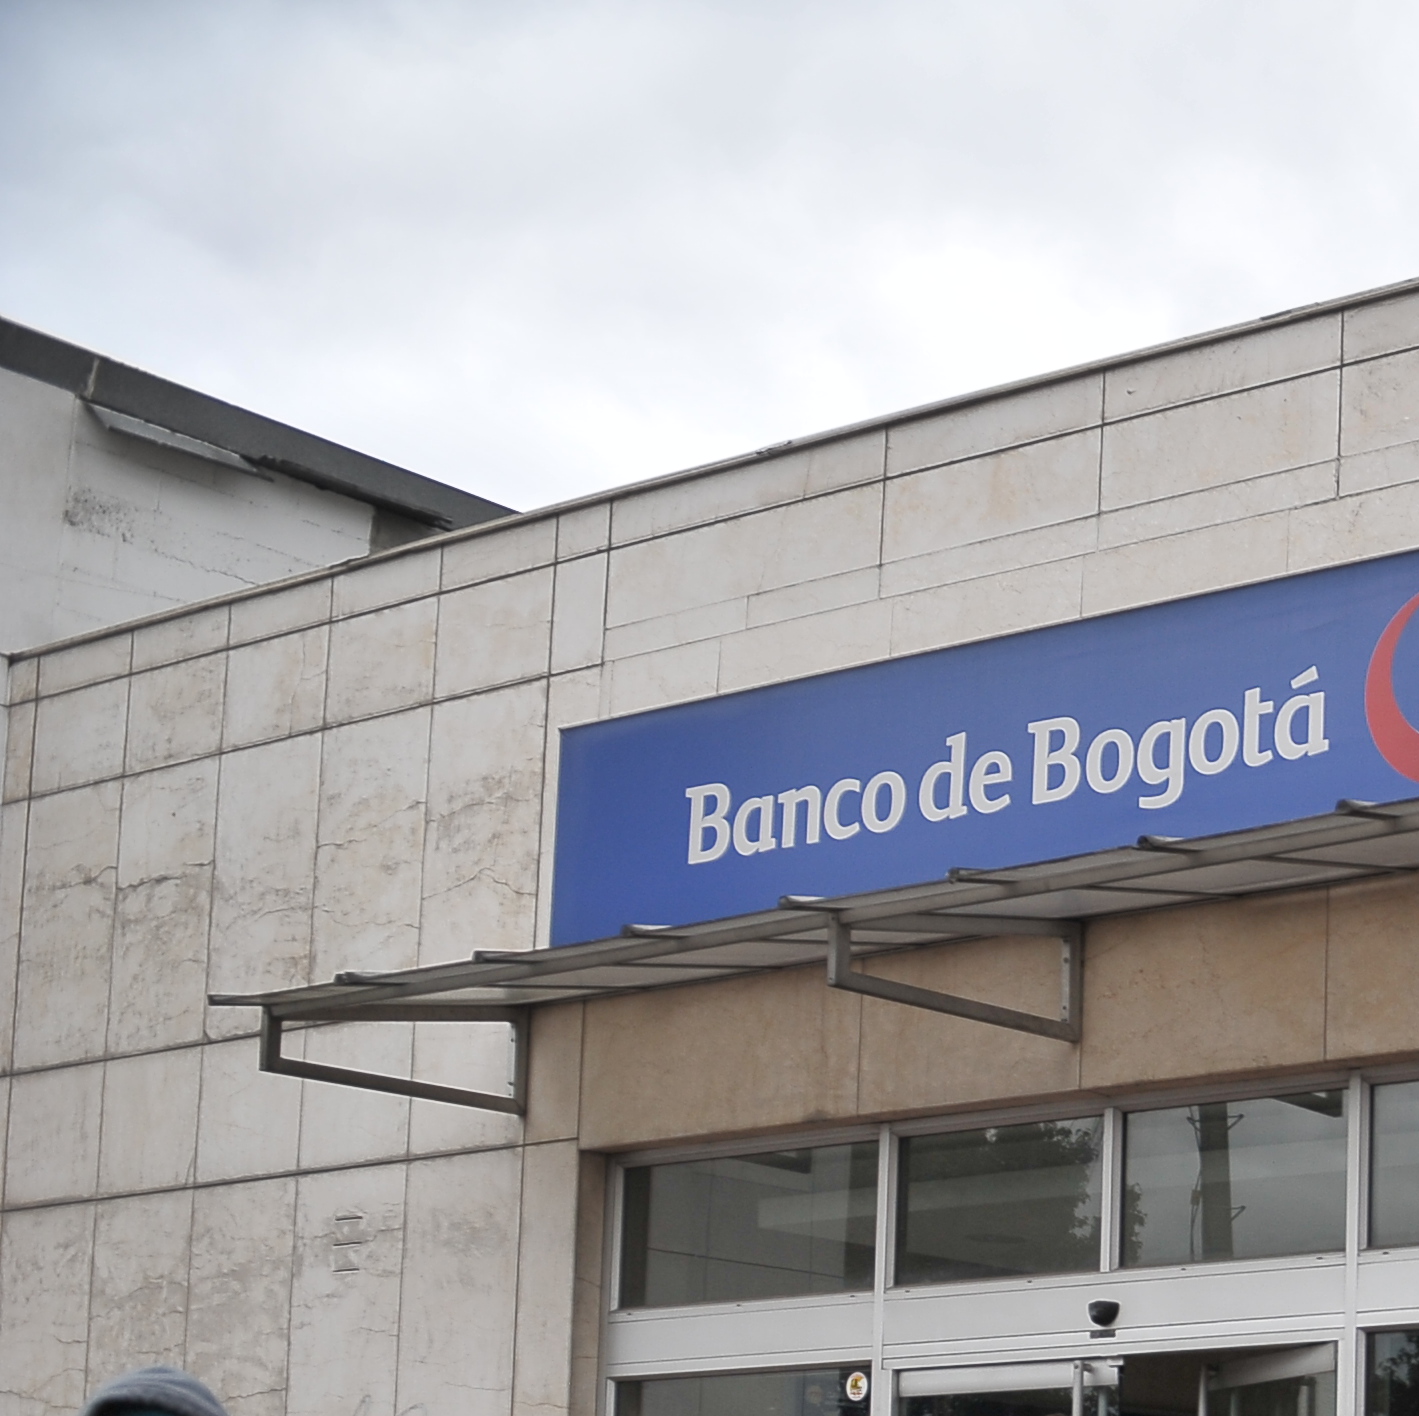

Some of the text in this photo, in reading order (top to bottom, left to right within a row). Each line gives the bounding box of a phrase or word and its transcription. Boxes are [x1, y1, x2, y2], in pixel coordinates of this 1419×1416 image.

[685, 665, 1330, 866] Banco de Bogotá
